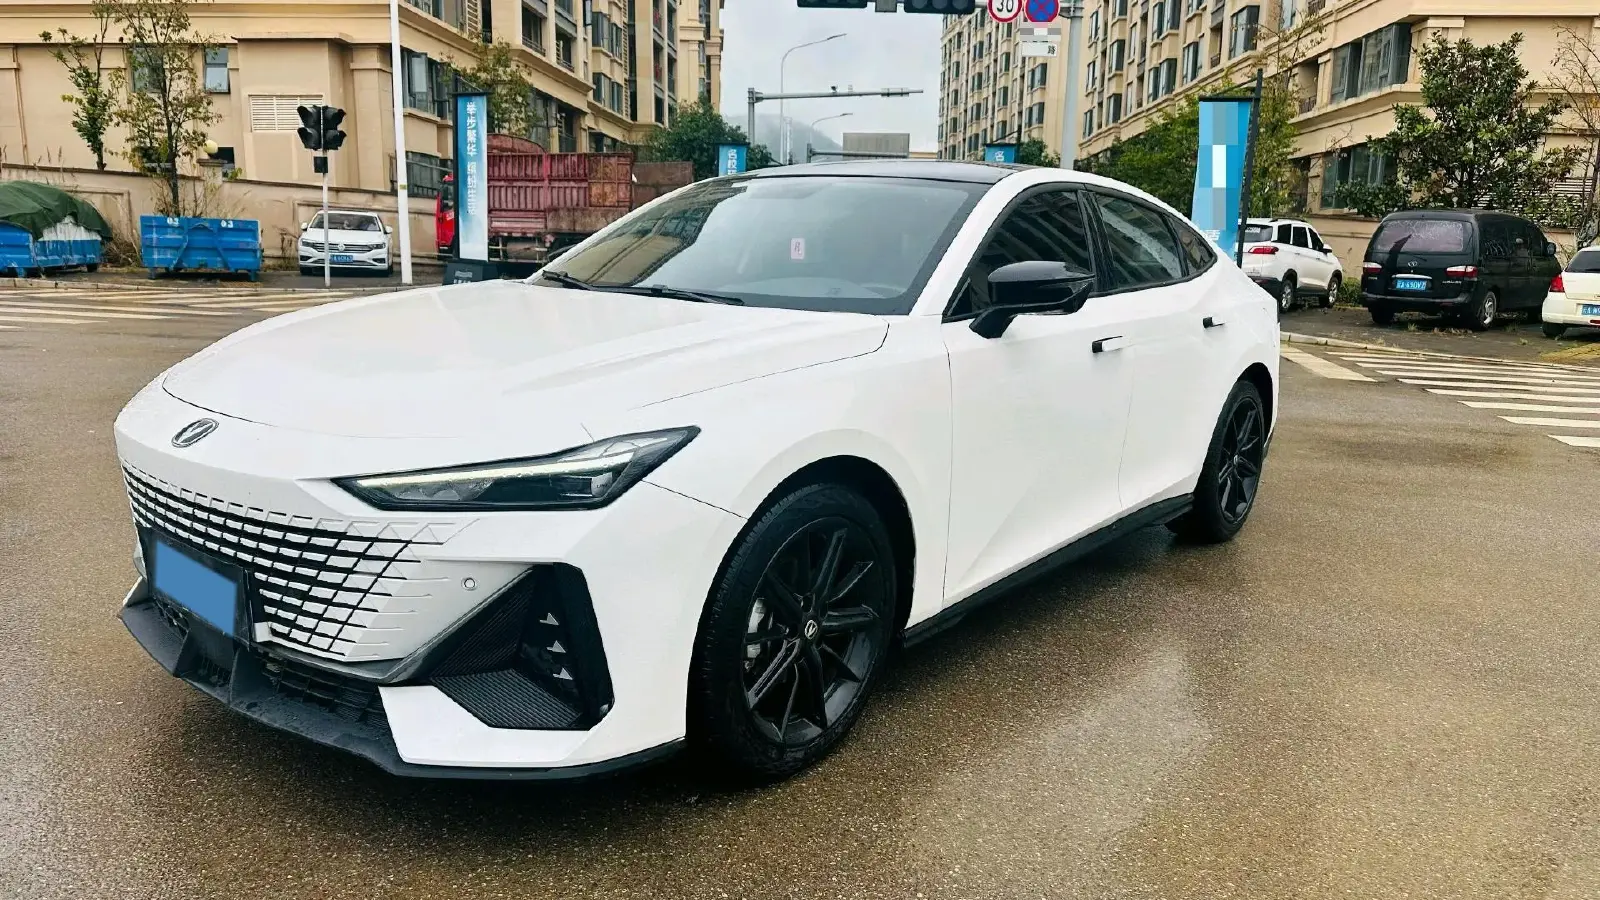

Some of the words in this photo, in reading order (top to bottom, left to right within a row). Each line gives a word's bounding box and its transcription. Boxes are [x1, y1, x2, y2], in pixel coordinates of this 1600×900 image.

[996, 0, 1014, 13] 30
[466, 101, 478, 157] 举步繁华
[995, 150, 1005, 162] 名
